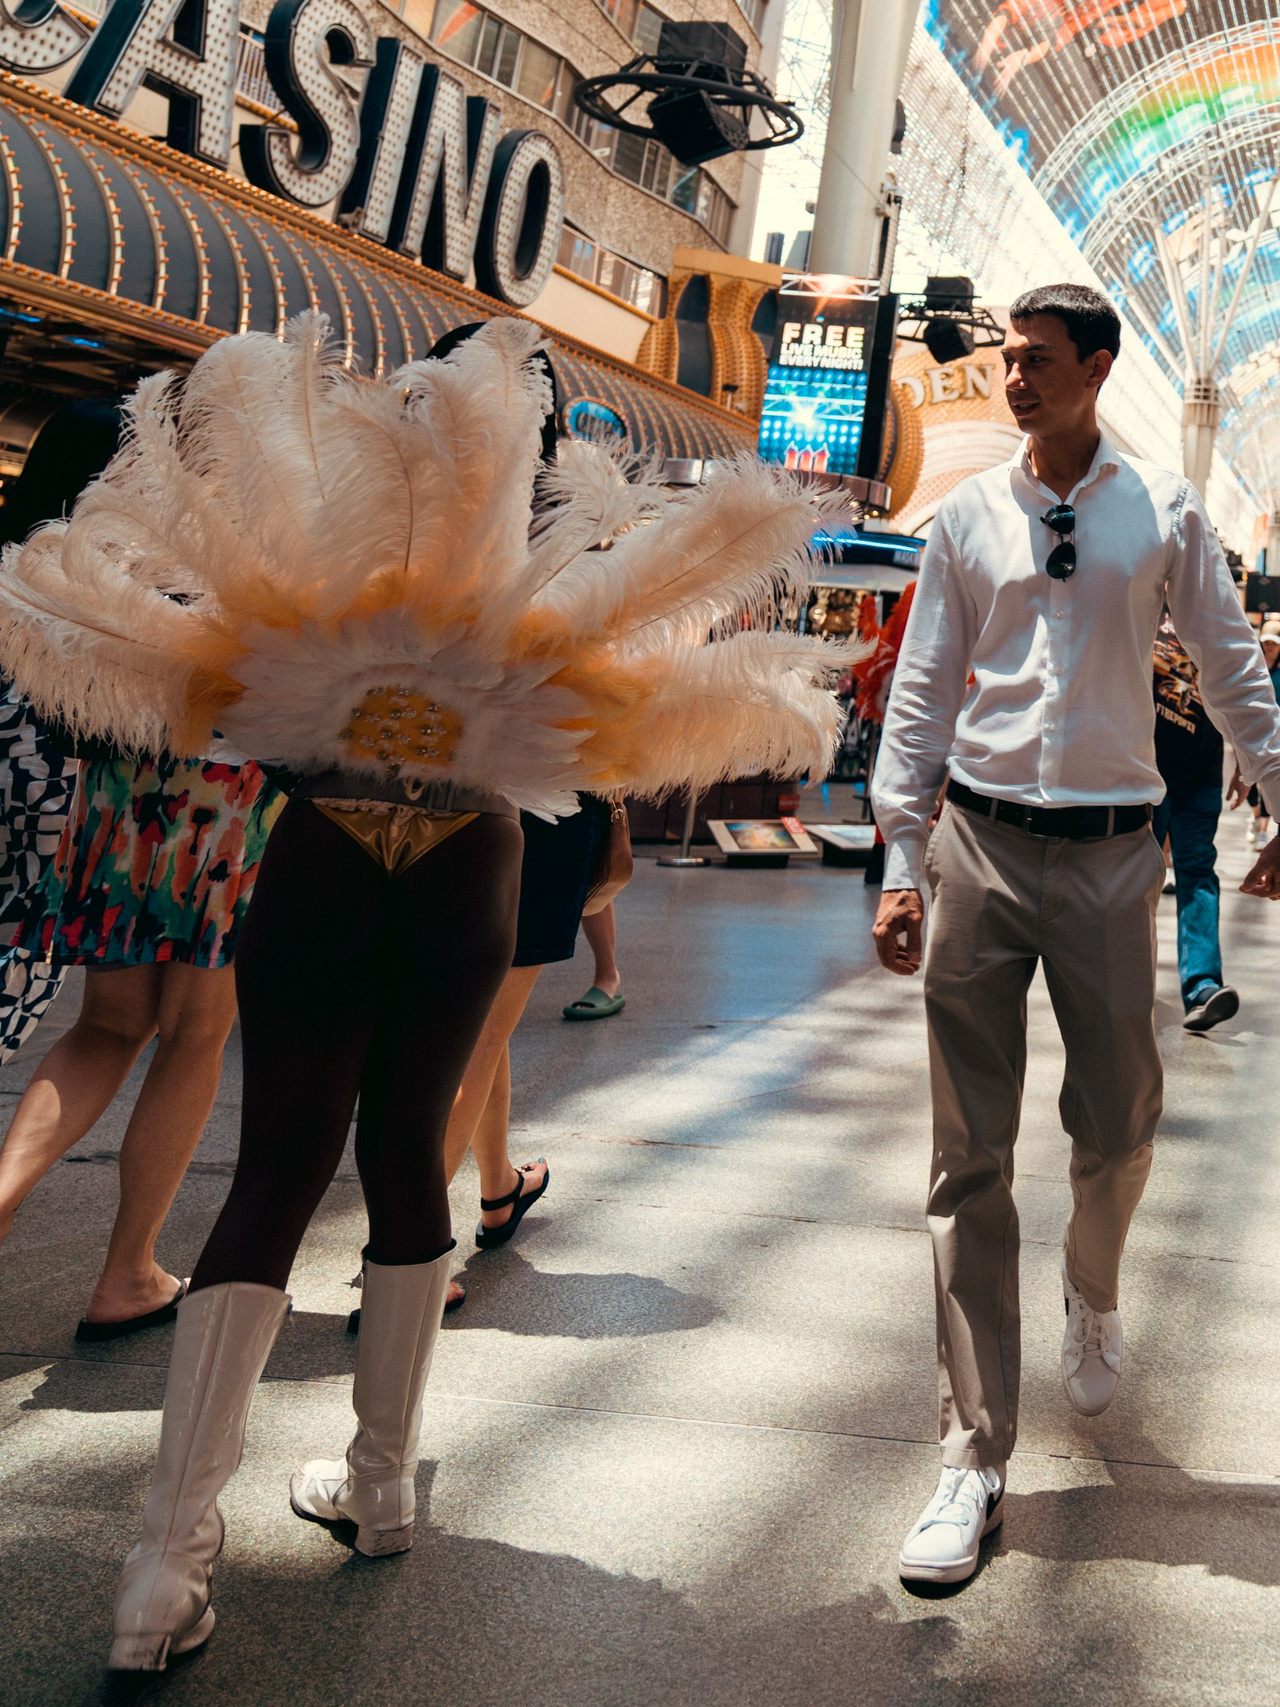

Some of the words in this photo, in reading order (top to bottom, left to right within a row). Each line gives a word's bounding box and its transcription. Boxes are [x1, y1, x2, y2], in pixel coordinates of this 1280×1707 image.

[782, 321, 865, 347] FREE
[781, 342, 813, 356] LIVE
[813, 344, 862, 359] MUSIC
[779, 354, 820, 367] EVERY
[820, 357, 864, 371] NIGHT!
